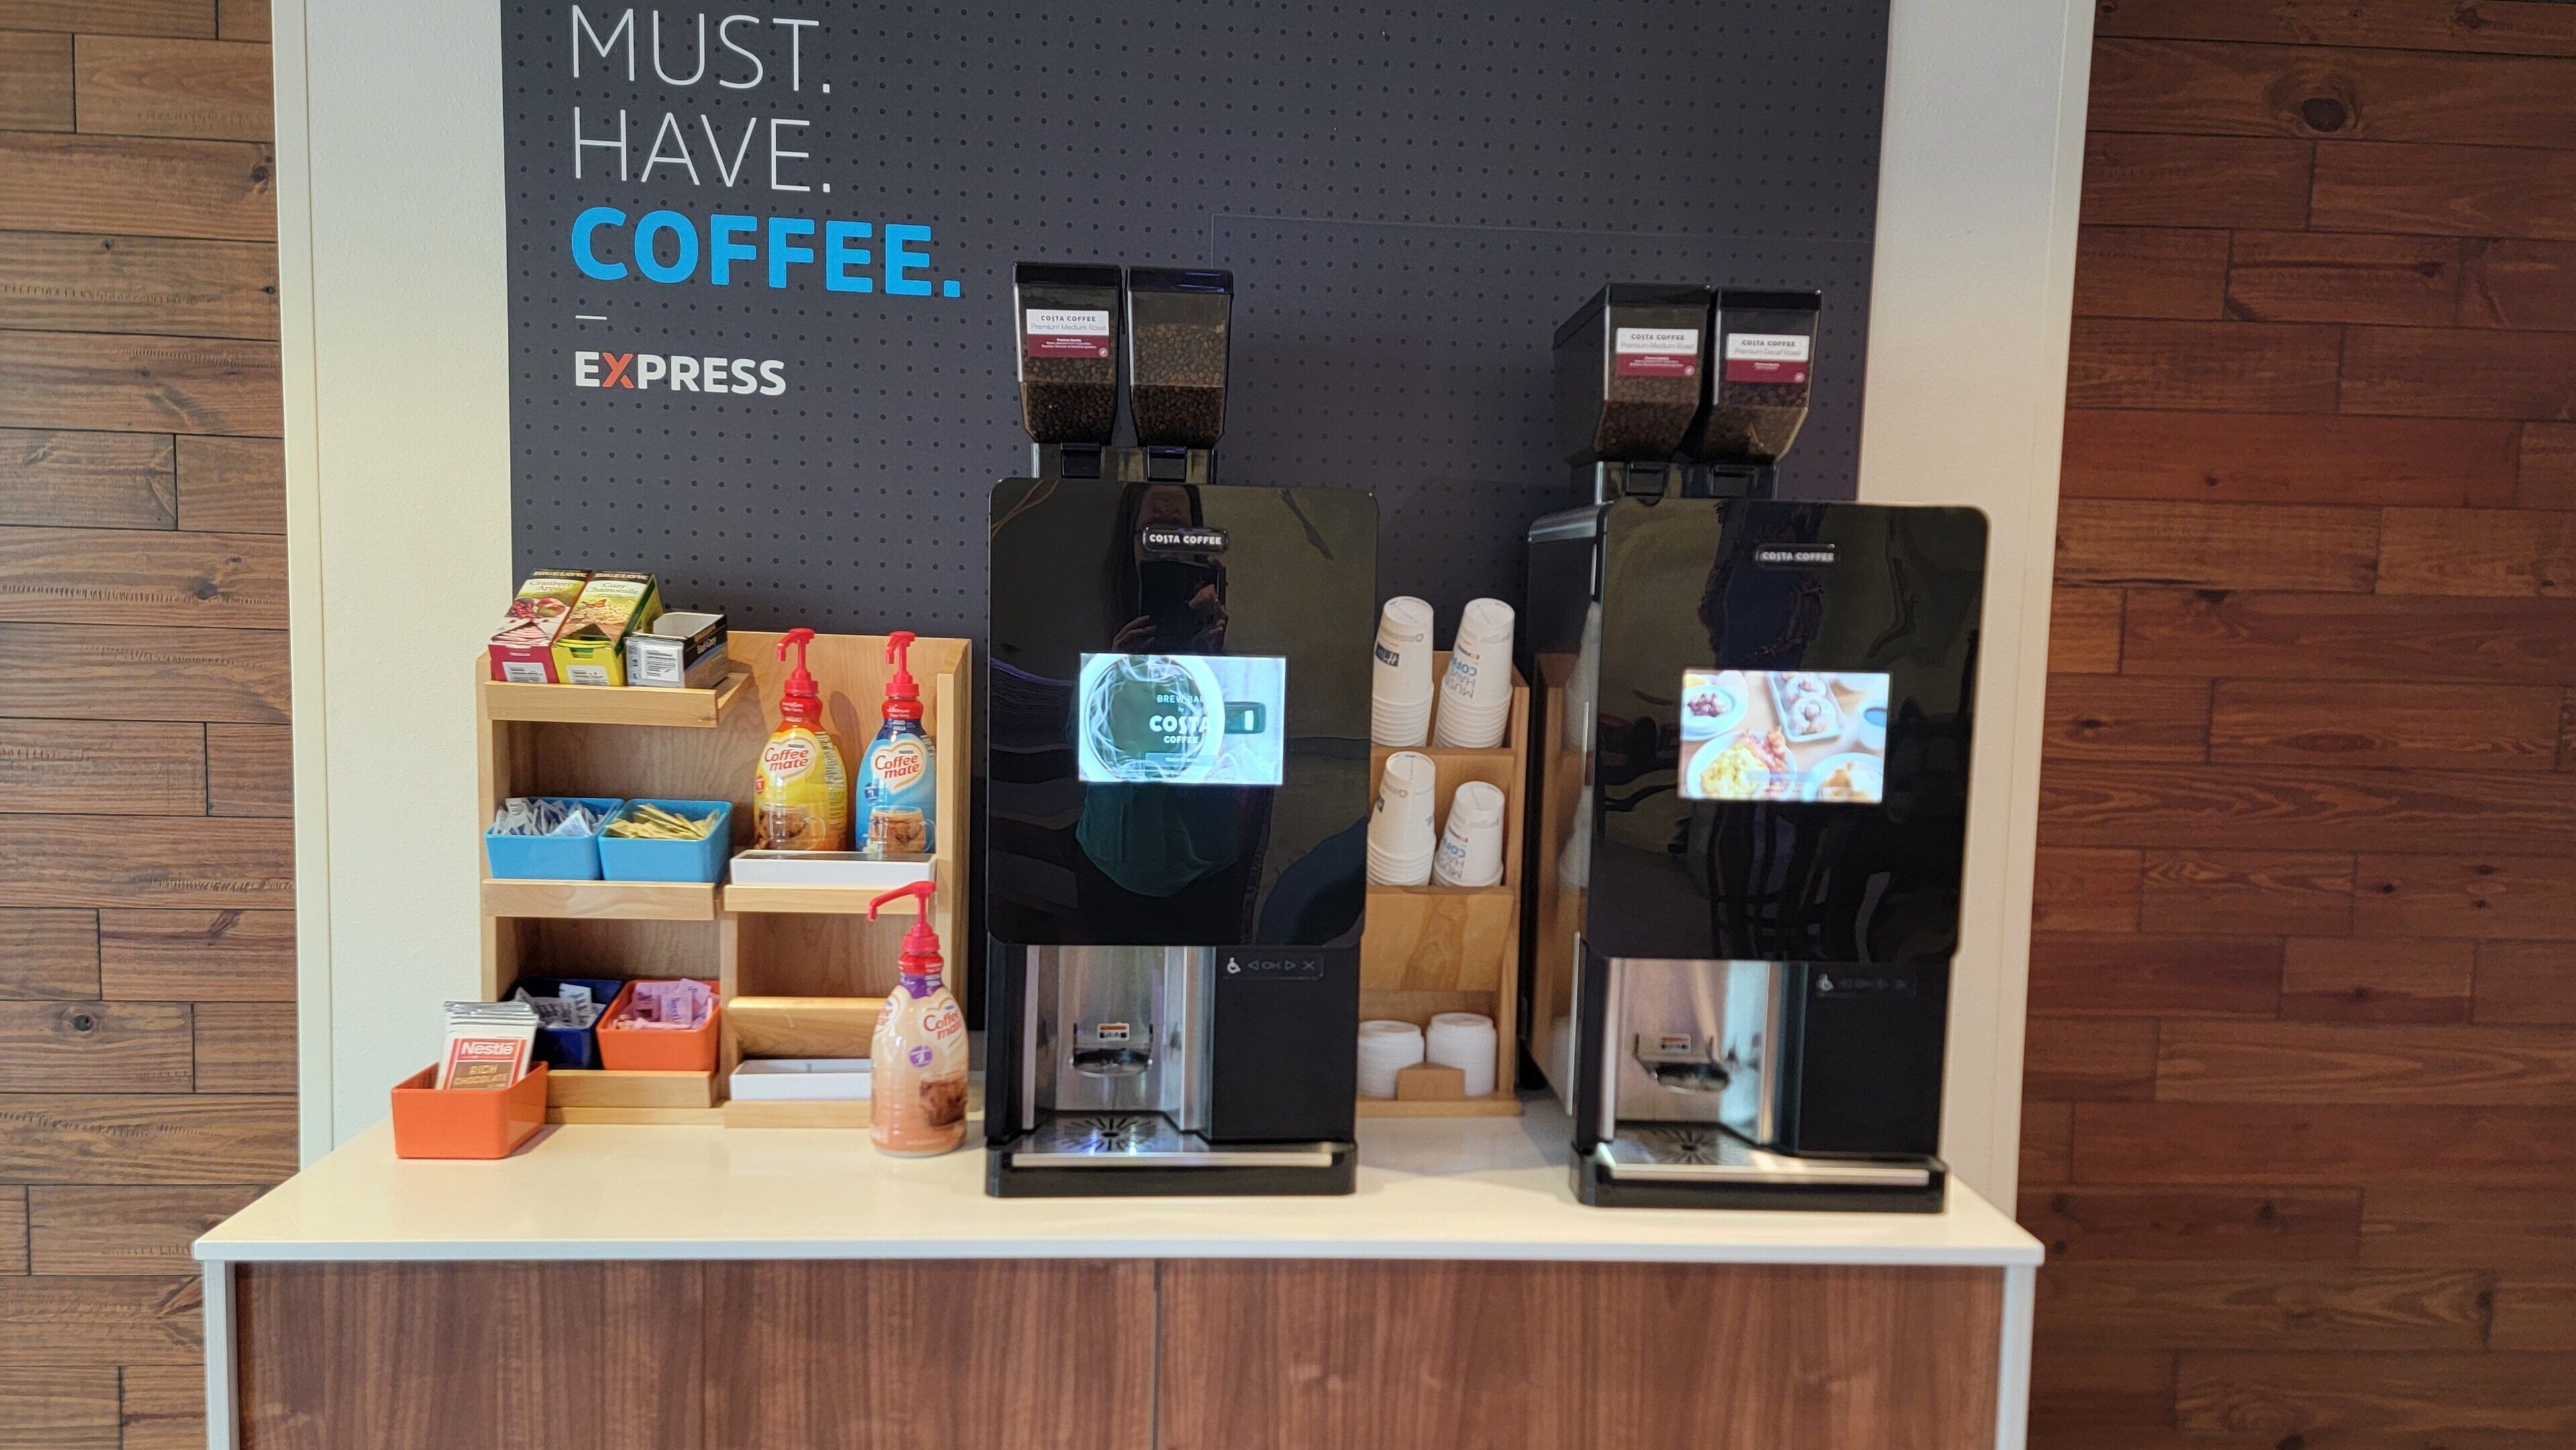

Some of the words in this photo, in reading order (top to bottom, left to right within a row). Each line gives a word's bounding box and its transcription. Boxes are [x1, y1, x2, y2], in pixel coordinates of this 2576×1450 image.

[572, 5, 830, 93] MUST.
[575, 107, 830, 193] HAVE.
[571, 207, 961, 297] COFFEE.
[575, 351, 786, 396] EXPRESS
[1149, 534, 1180, 544] COSTA
[1183, 535, 1222, 545] COFFEE
[1760, 552, 1793, 562] COSTA
[1794, 552, 1835, 562] COFFEE
[1157, 695, 1185, 703] BREW
[1149, 715, 1210, 734] COSTA
[1163, 735, 1199, 743] COFFEE
[765, 747, 809, 762] Coffee
[769, 758, 808, 771] mate
[875, 755, 918, 770] Coffee
[884, 764, 920, 779] mate
[470, 1064, 498, 1074] RICH
